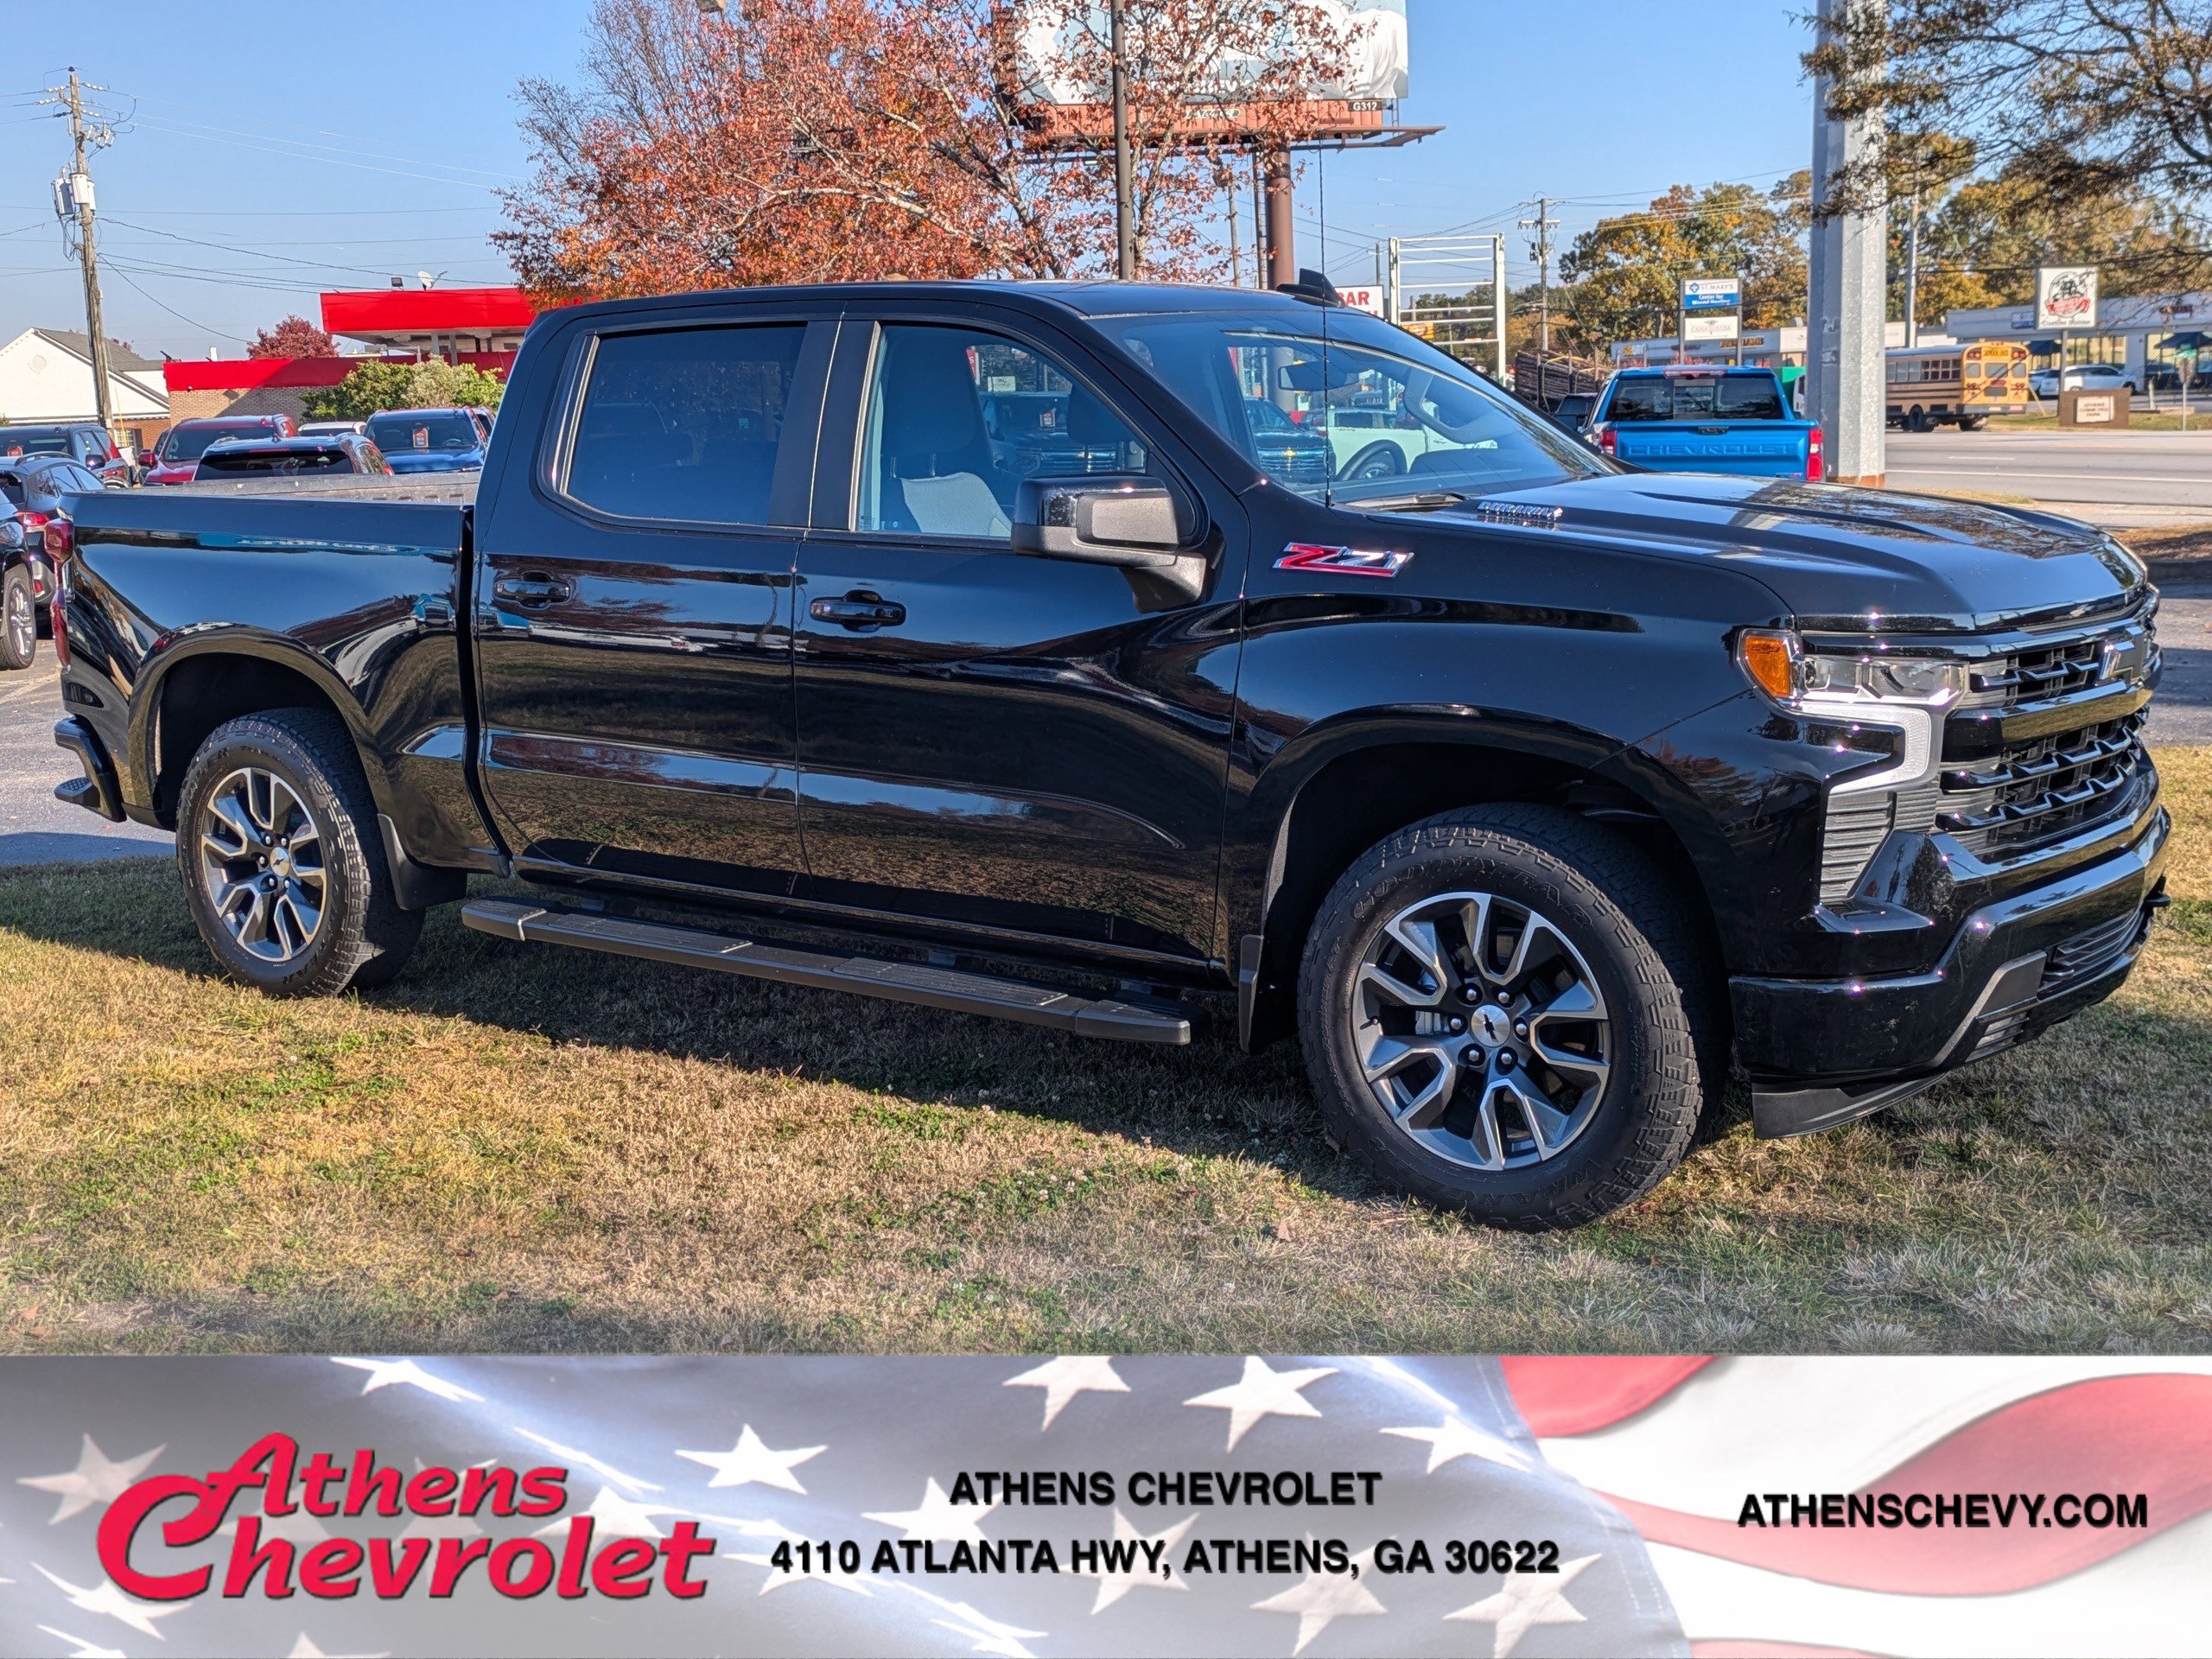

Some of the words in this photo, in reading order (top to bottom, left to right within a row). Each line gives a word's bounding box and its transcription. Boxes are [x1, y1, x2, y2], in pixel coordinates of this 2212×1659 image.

[1352, 101, 1377, 111] G312
[1628, 443, 1795, 456] CHEVROLET
[1273, 541, 1414, 578] Z71
[1352, 855, 1593, 928] GOODYEAR
